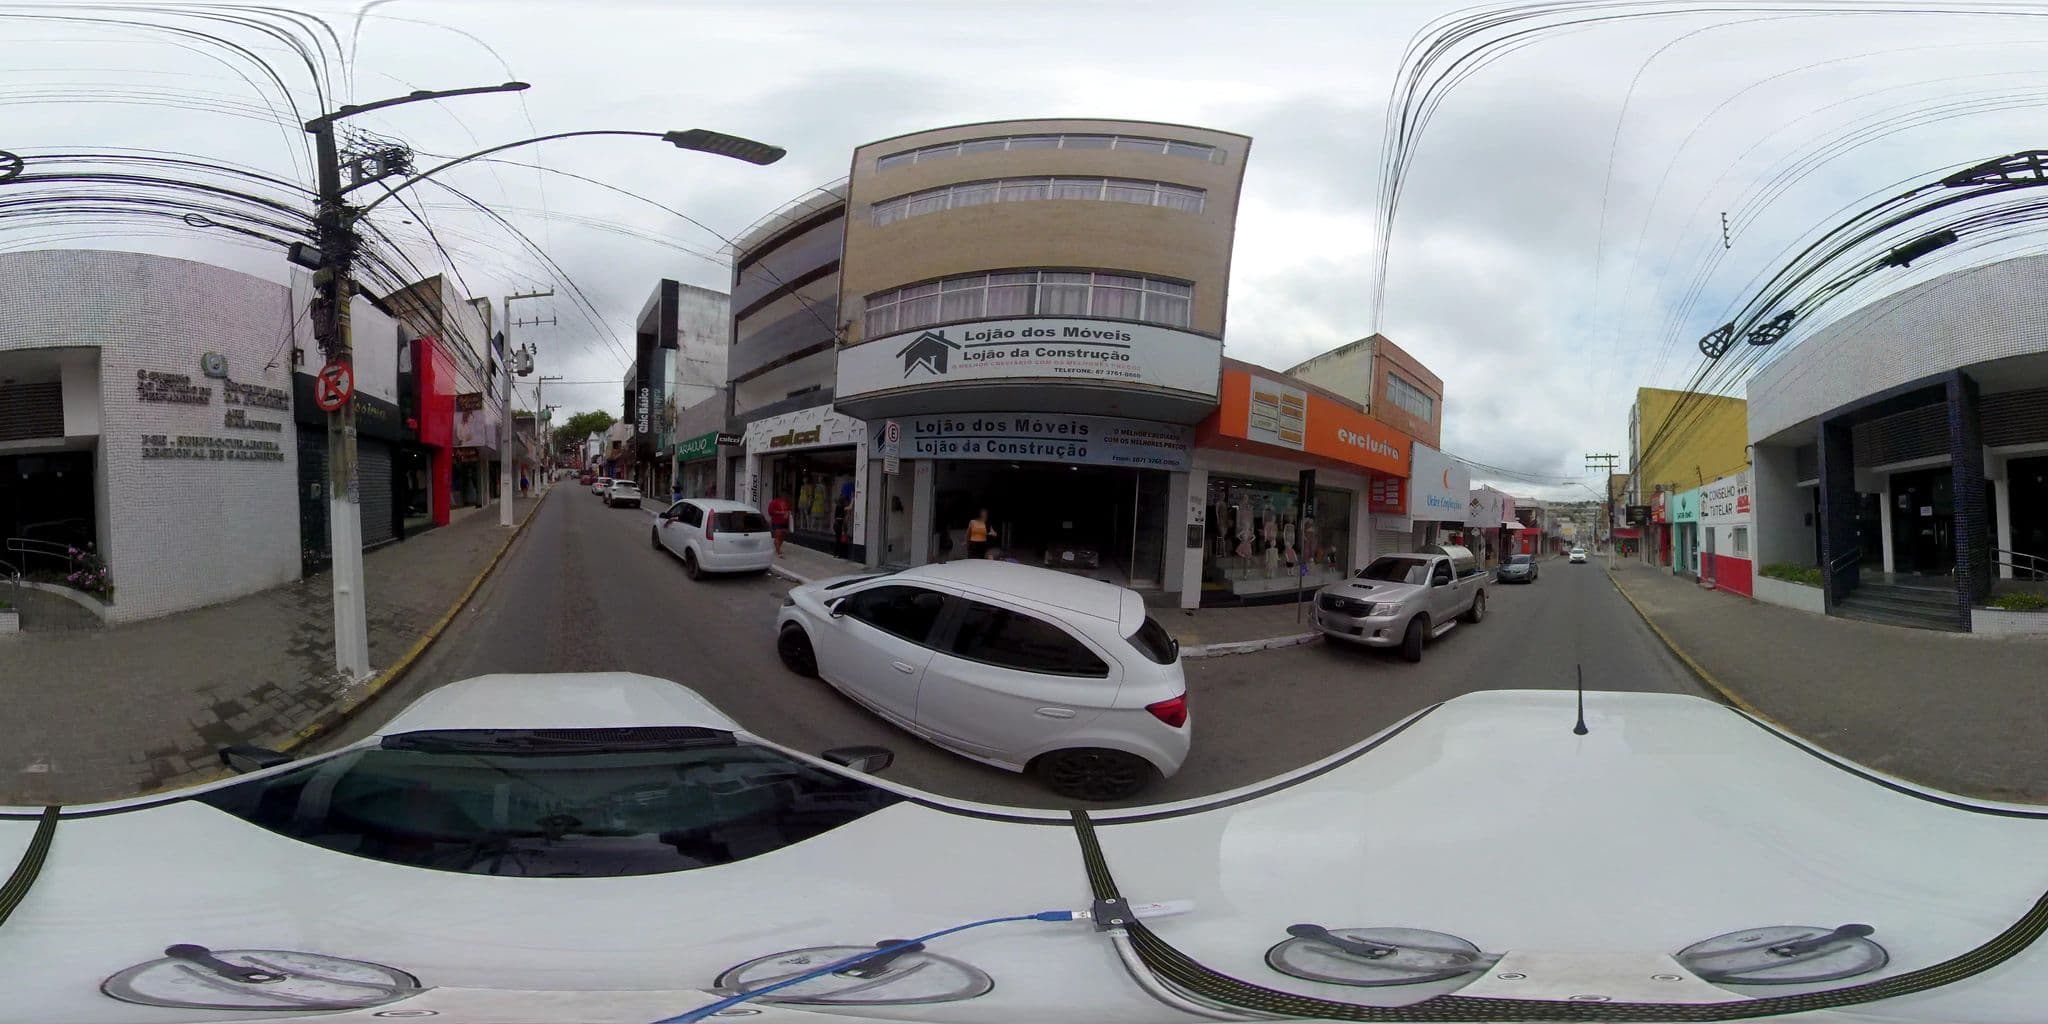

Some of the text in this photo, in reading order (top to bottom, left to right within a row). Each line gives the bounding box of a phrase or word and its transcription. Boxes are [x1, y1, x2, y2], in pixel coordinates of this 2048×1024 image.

[964, 327, 1132, 342] Lojão dos Móveis
[963, 347, 1130, 361] Lojão da Construção
[915, 419, 1088, 435] Lojão dos Móveis
[770, 423, 822, 448] colcci
[916, 440, 1087, 457] Lojão da Construção
[1337, 427, 1399, 462] exclusiva
[1709, 485, 1735, 501] CONSELHO
